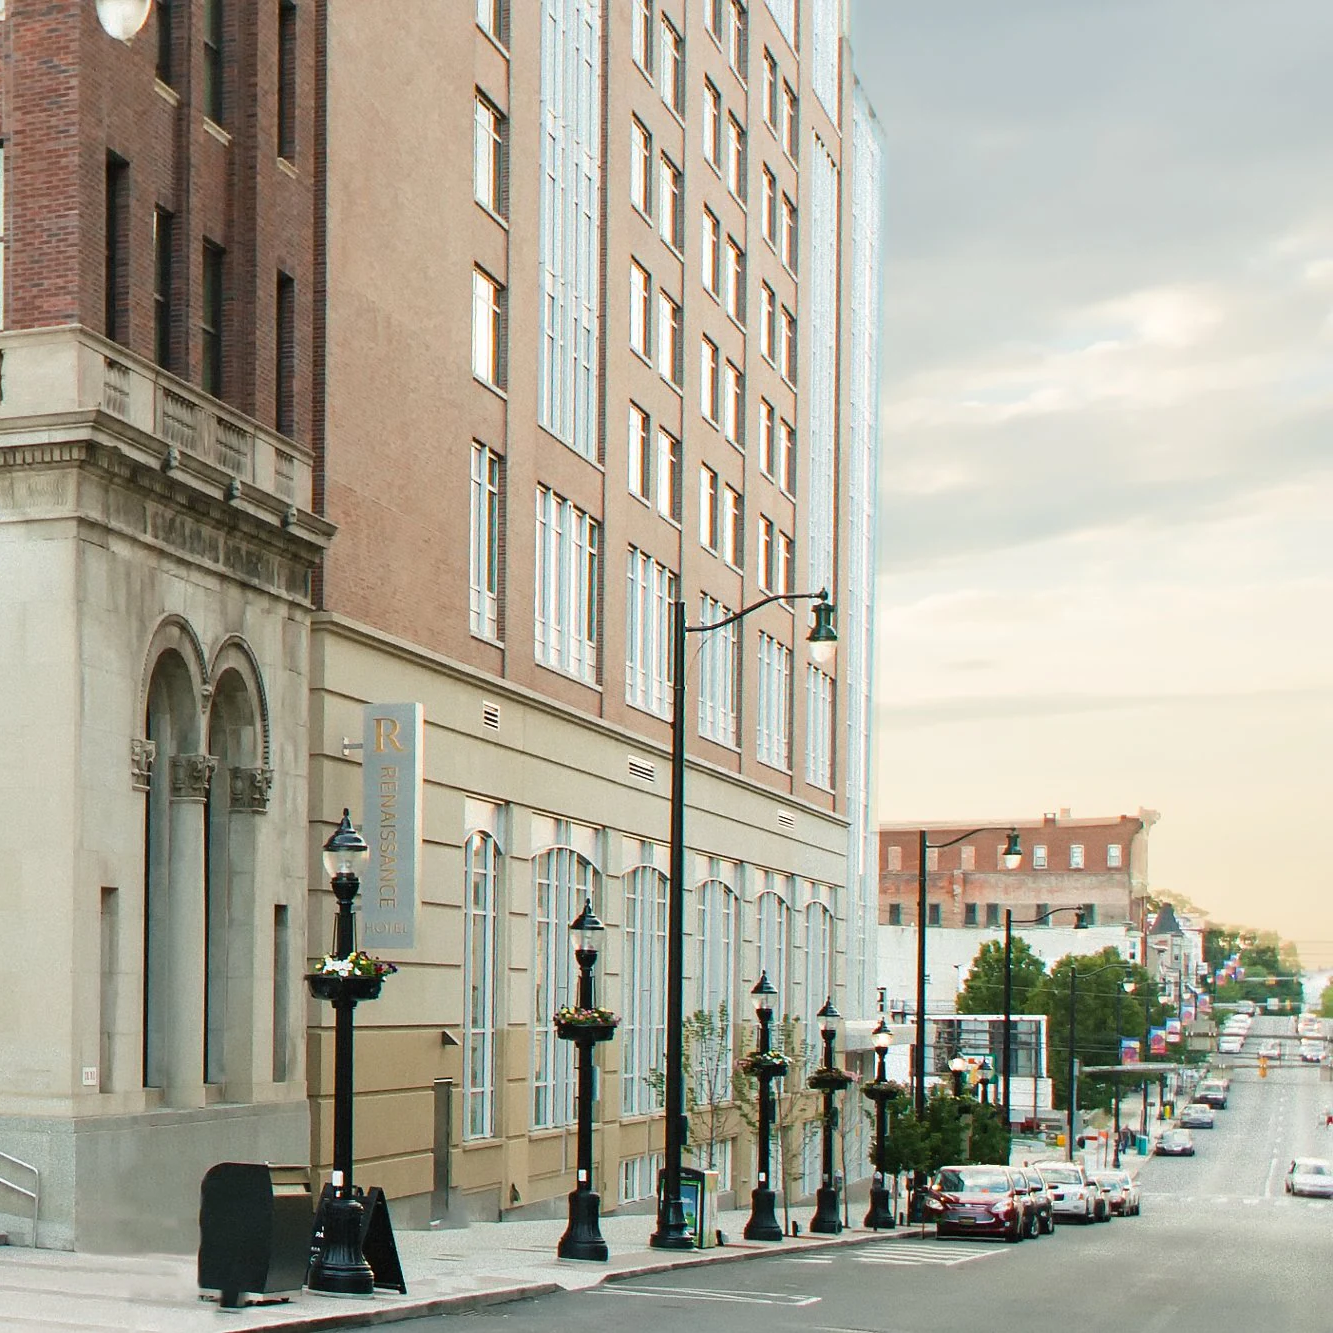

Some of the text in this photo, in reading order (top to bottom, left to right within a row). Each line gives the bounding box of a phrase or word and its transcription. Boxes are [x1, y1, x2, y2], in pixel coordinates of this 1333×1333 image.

[373, 718, 404, 752] R
[380, 766, 398, 908] RENAISSANCE
[365, 921, 408, 935] HOTEL
